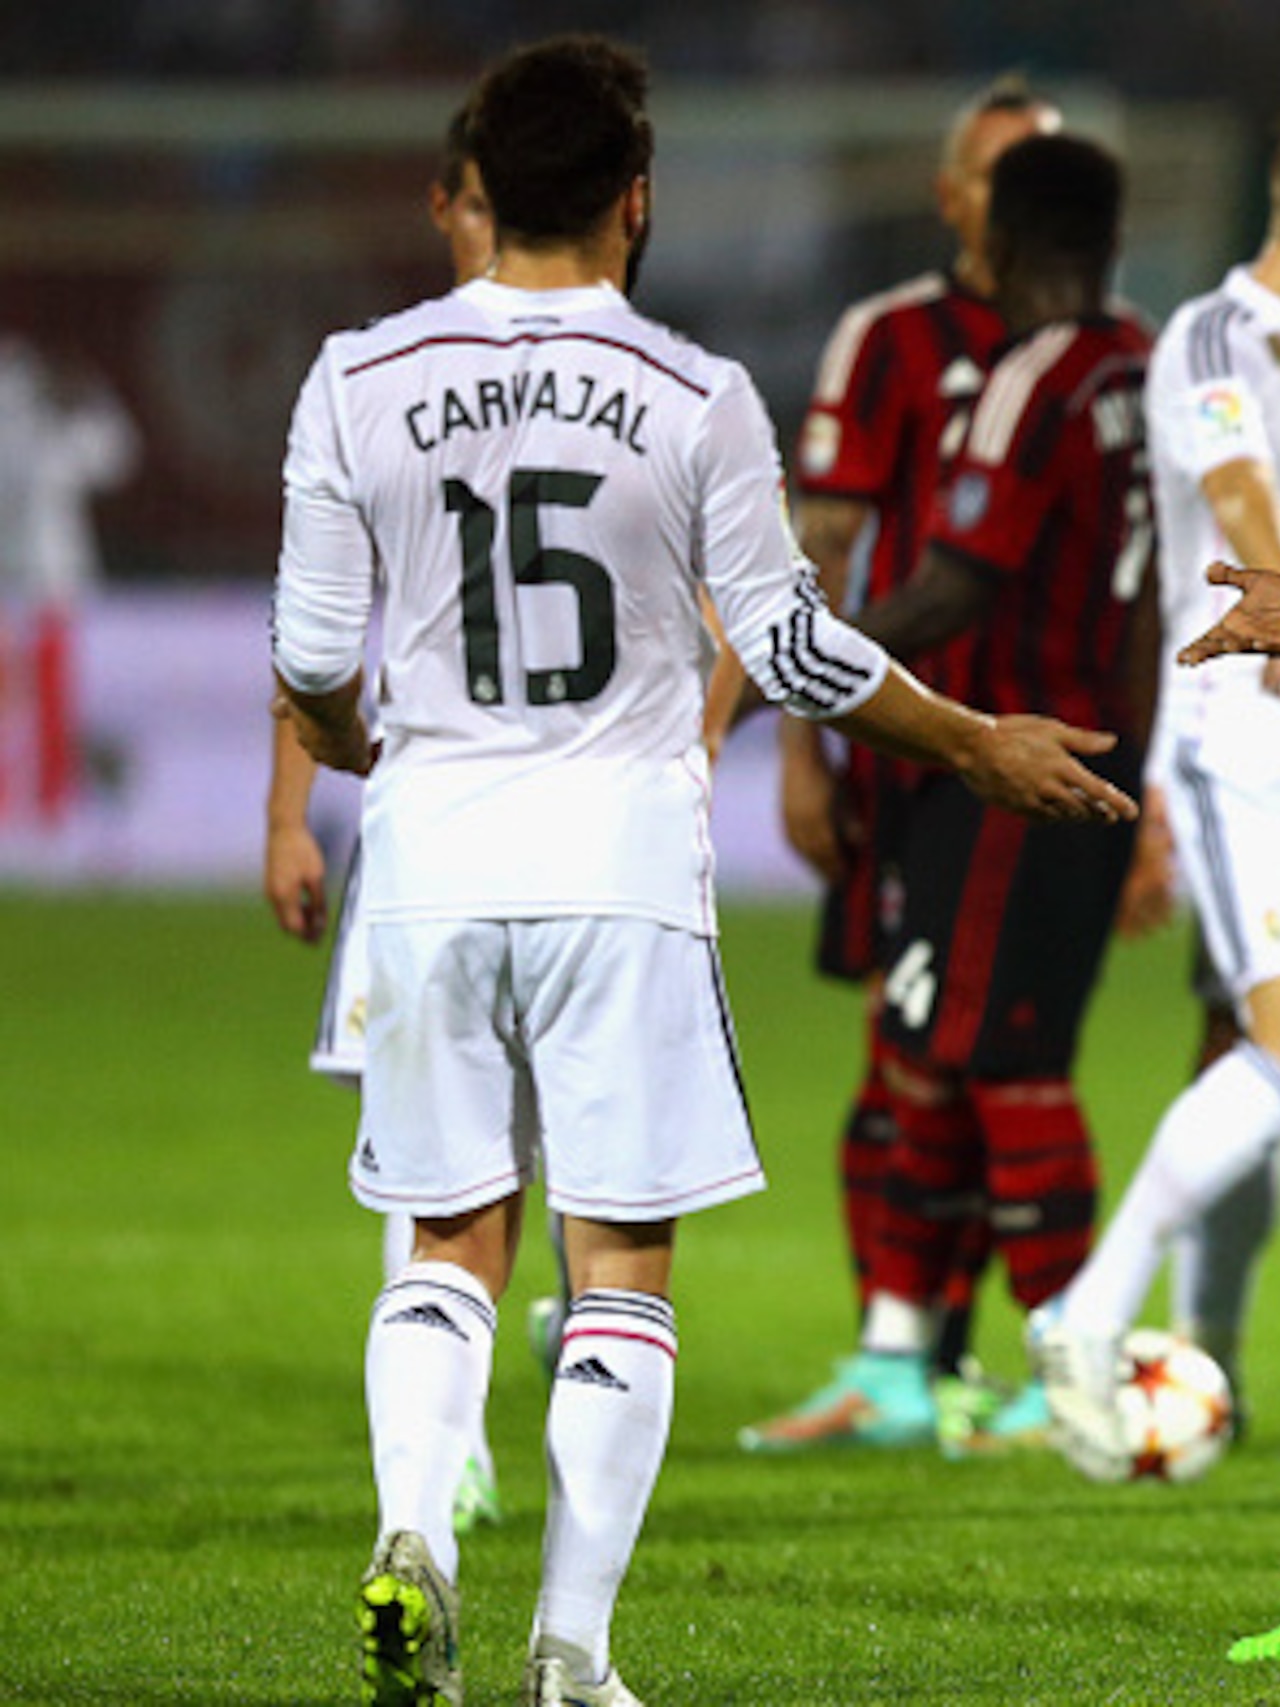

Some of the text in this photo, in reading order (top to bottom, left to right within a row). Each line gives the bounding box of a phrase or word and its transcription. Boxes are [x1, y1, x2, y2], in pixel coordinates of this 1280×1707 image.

[405, 371, 647, 455] CARVAJAL
[442, 467, 615, 705] 15
[886, 938, 935, 1028] 4
